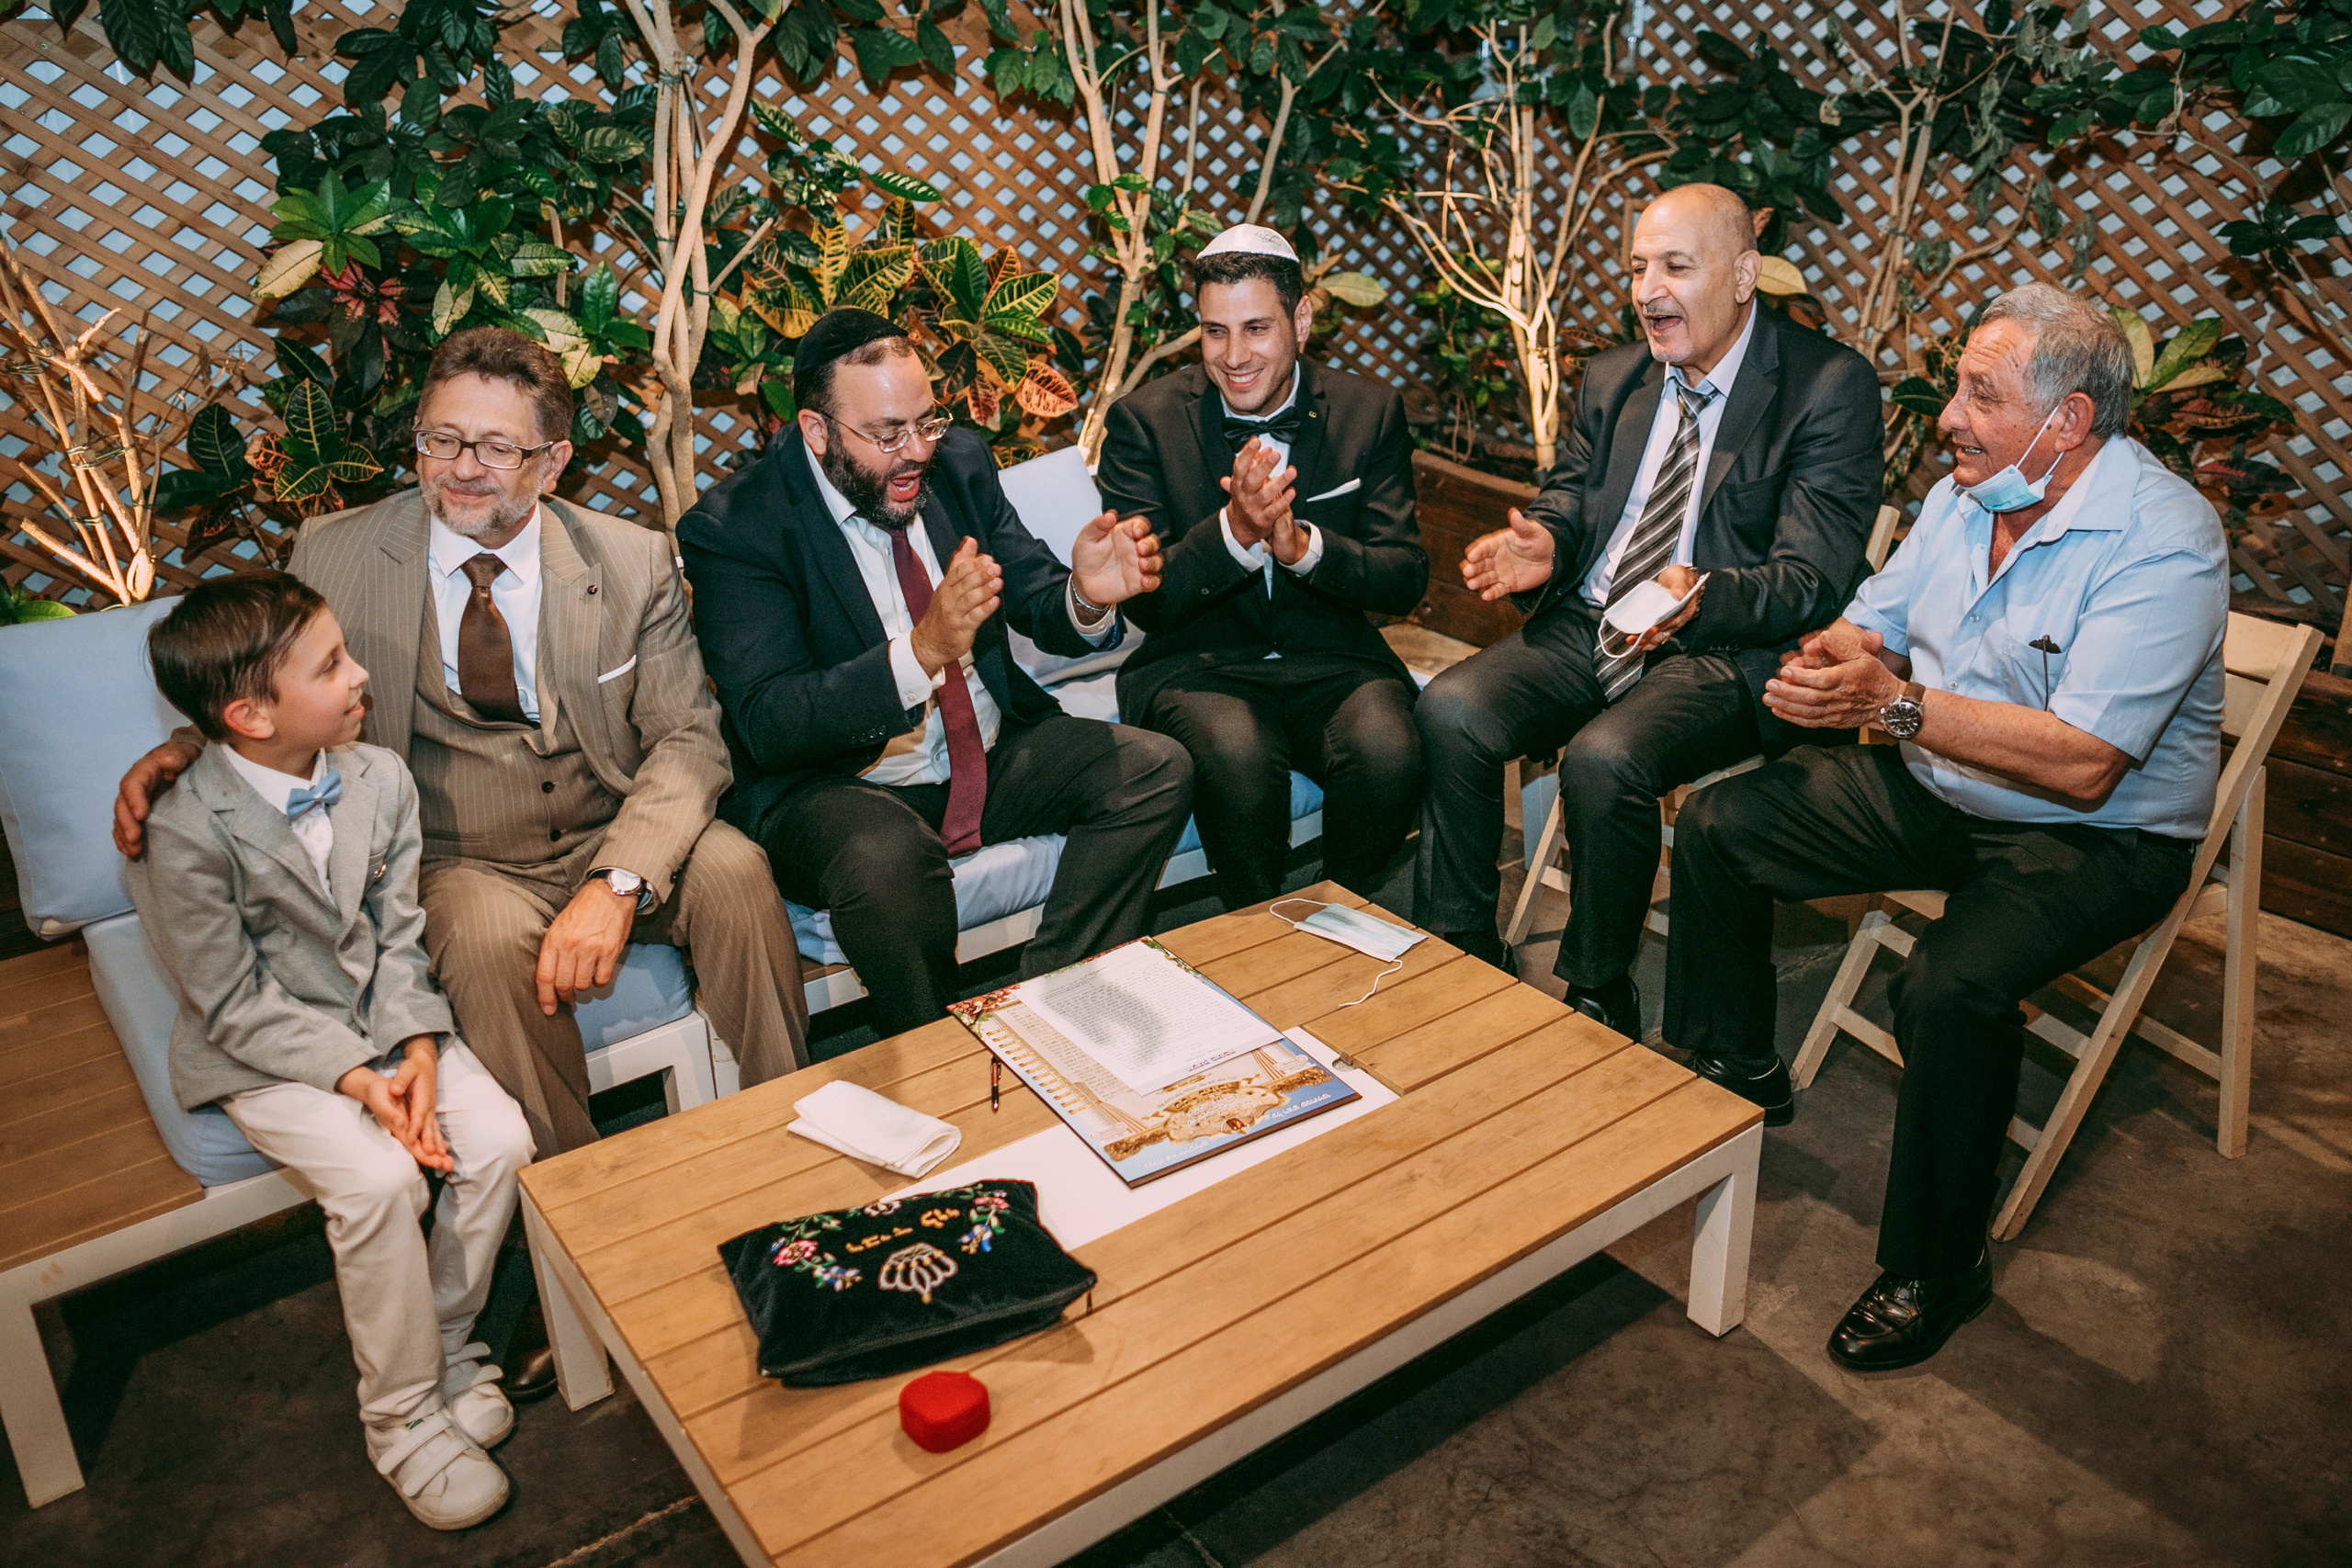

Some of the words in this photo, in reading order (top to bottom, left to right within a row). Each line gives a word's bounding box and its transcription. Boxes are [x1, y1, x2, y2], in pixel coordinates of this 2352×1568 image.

[1186, 1059, 1210, 1072] העתק
[1210, 1049, 1237, 1062] כתובה
[1173, 1096, 1198, 1110] שטר
[1198, 1082, 1239, 1096] כתובה
[1272, 1111, 1284, 1119] על
[1283, 1104, 1300, 1114] ראש
